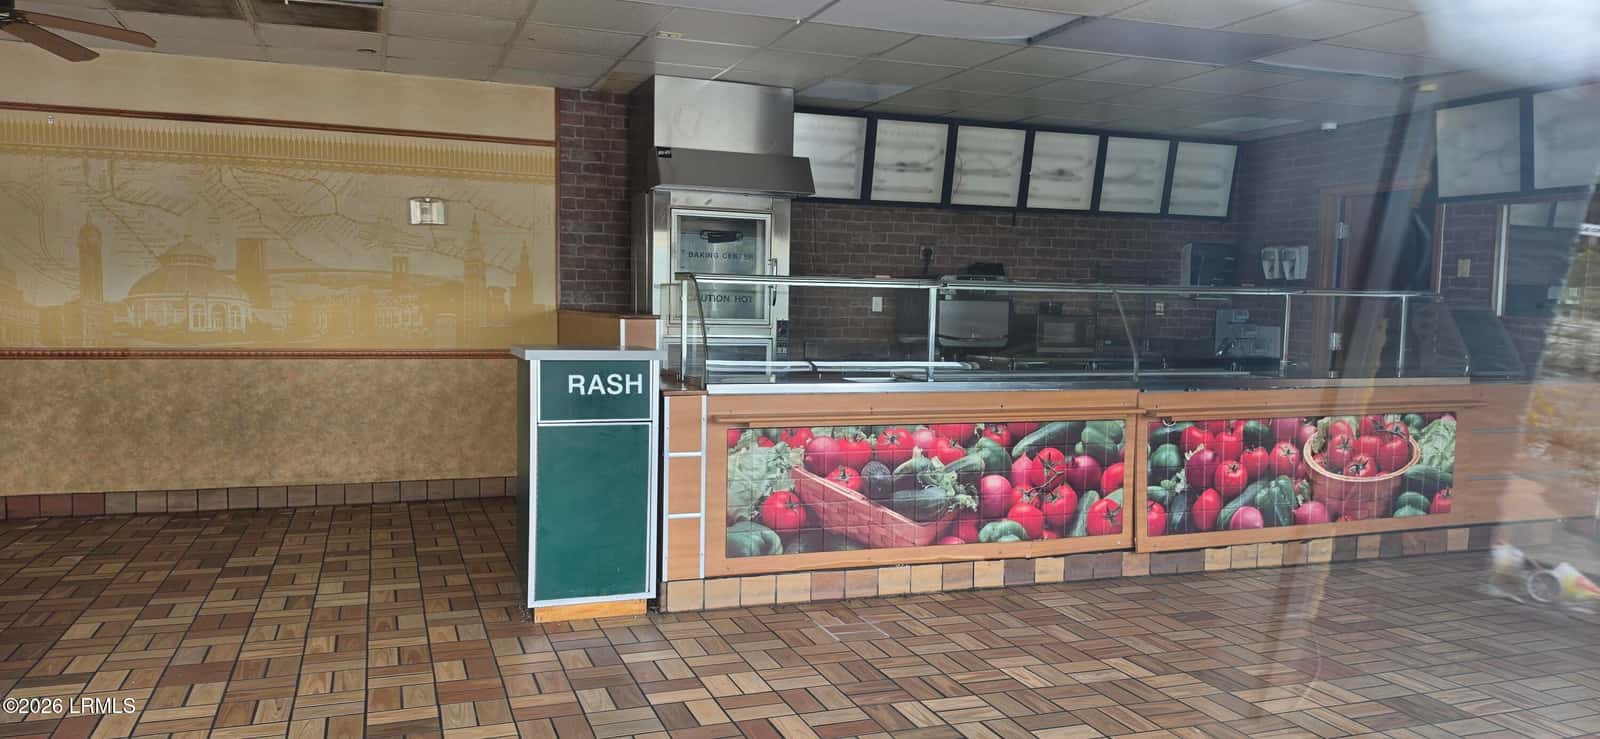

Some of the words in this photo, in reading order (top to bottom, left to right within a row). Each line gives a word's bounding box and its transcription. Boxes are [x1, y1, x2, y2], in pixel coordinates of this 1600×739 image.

[688, 250, 719, 259] BAKING
[734, 294, 753, 304] HOT
[567, 373, 643, 396] RASH
